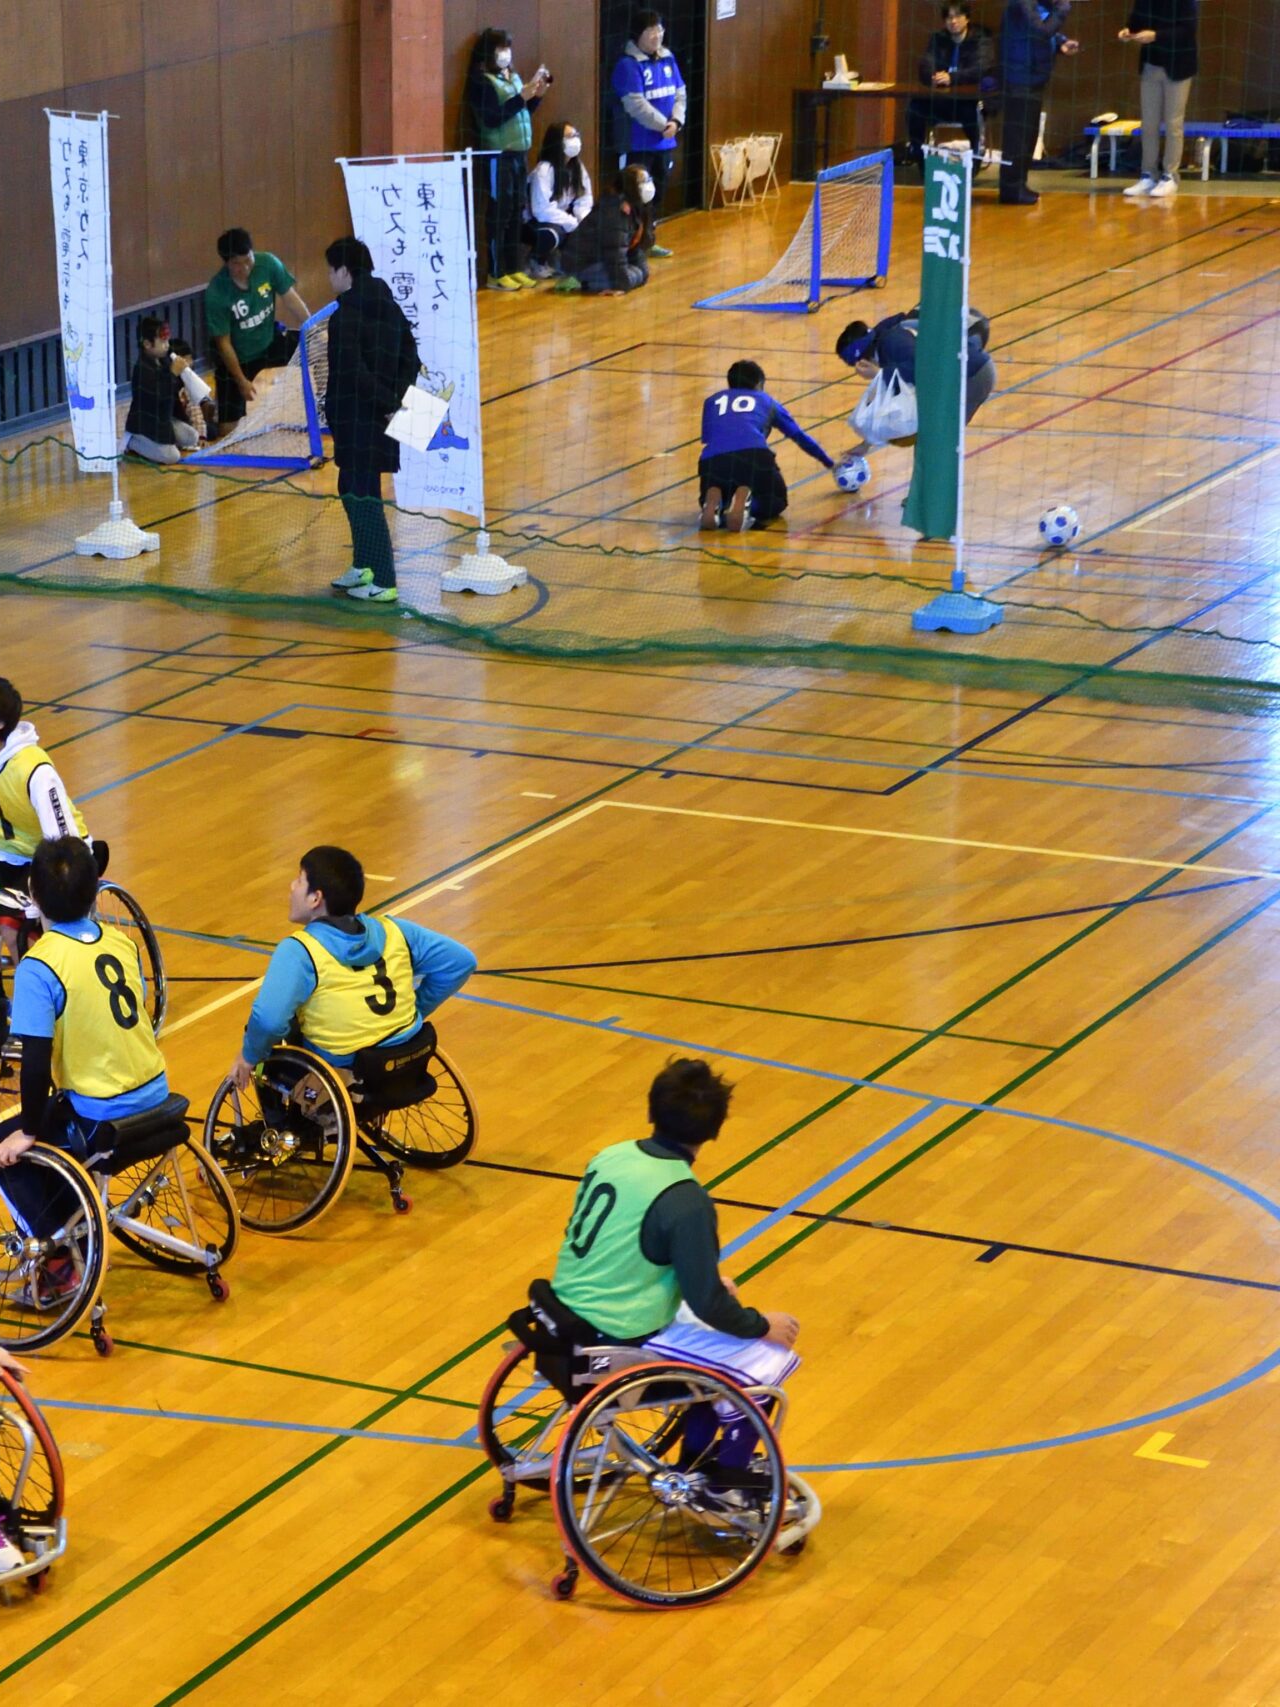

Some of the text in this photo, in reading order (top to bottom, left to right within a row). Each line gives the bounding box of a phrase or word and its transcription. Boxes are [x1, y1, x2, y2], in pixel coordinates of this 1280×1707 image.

[643, 68, 654, 86] 2
[231, 300, 249, 319] 16
[714, 395, 756, 416] 10
[95, 953, 139, 1030] 8
[351, 955, 397, 1016] 3
[564, 1170, 617, 1259] 10
